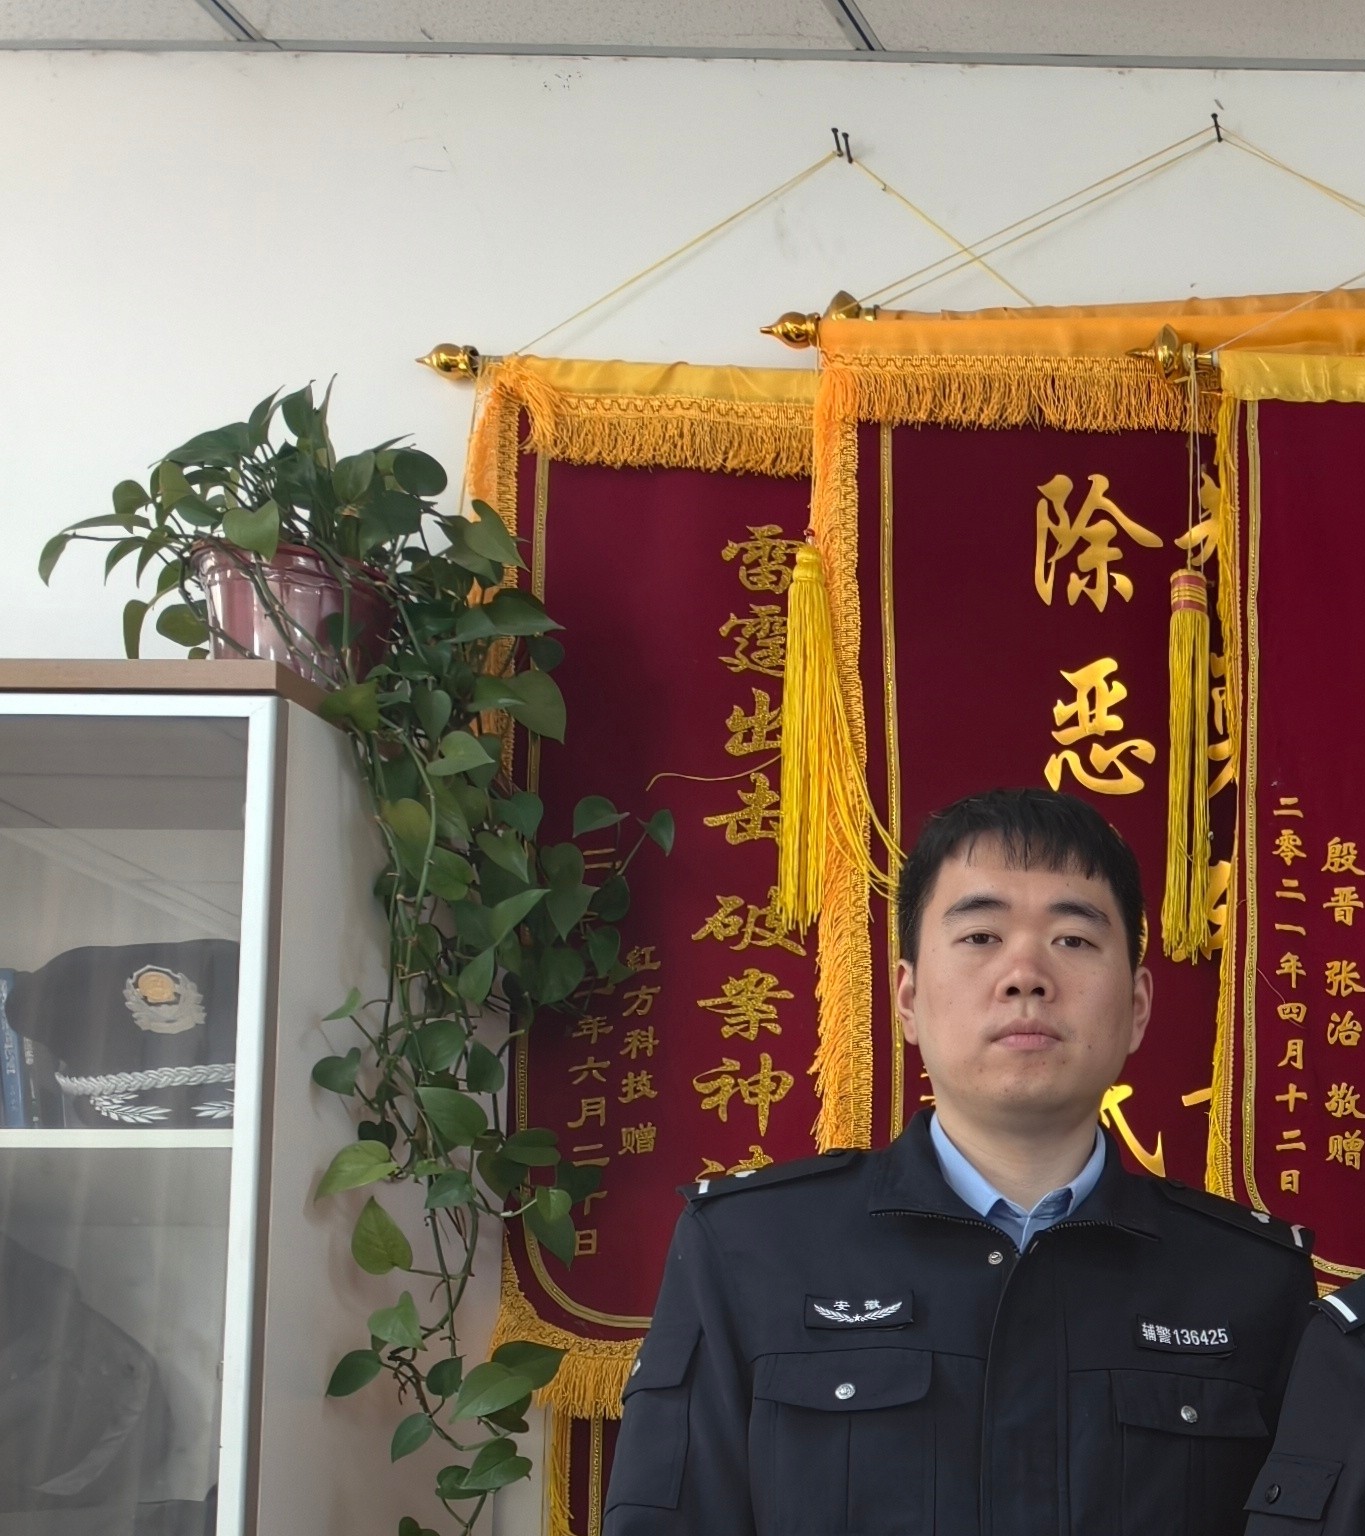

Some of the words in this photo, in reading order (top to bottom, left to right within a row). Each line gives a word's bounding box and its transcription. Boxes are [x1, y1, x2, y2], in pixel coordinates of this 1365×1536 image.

[691, 524, 807, 1183] 雷霆出击破案神
[1272, 797, 1307, 1194] 二零二一年四月十二日
